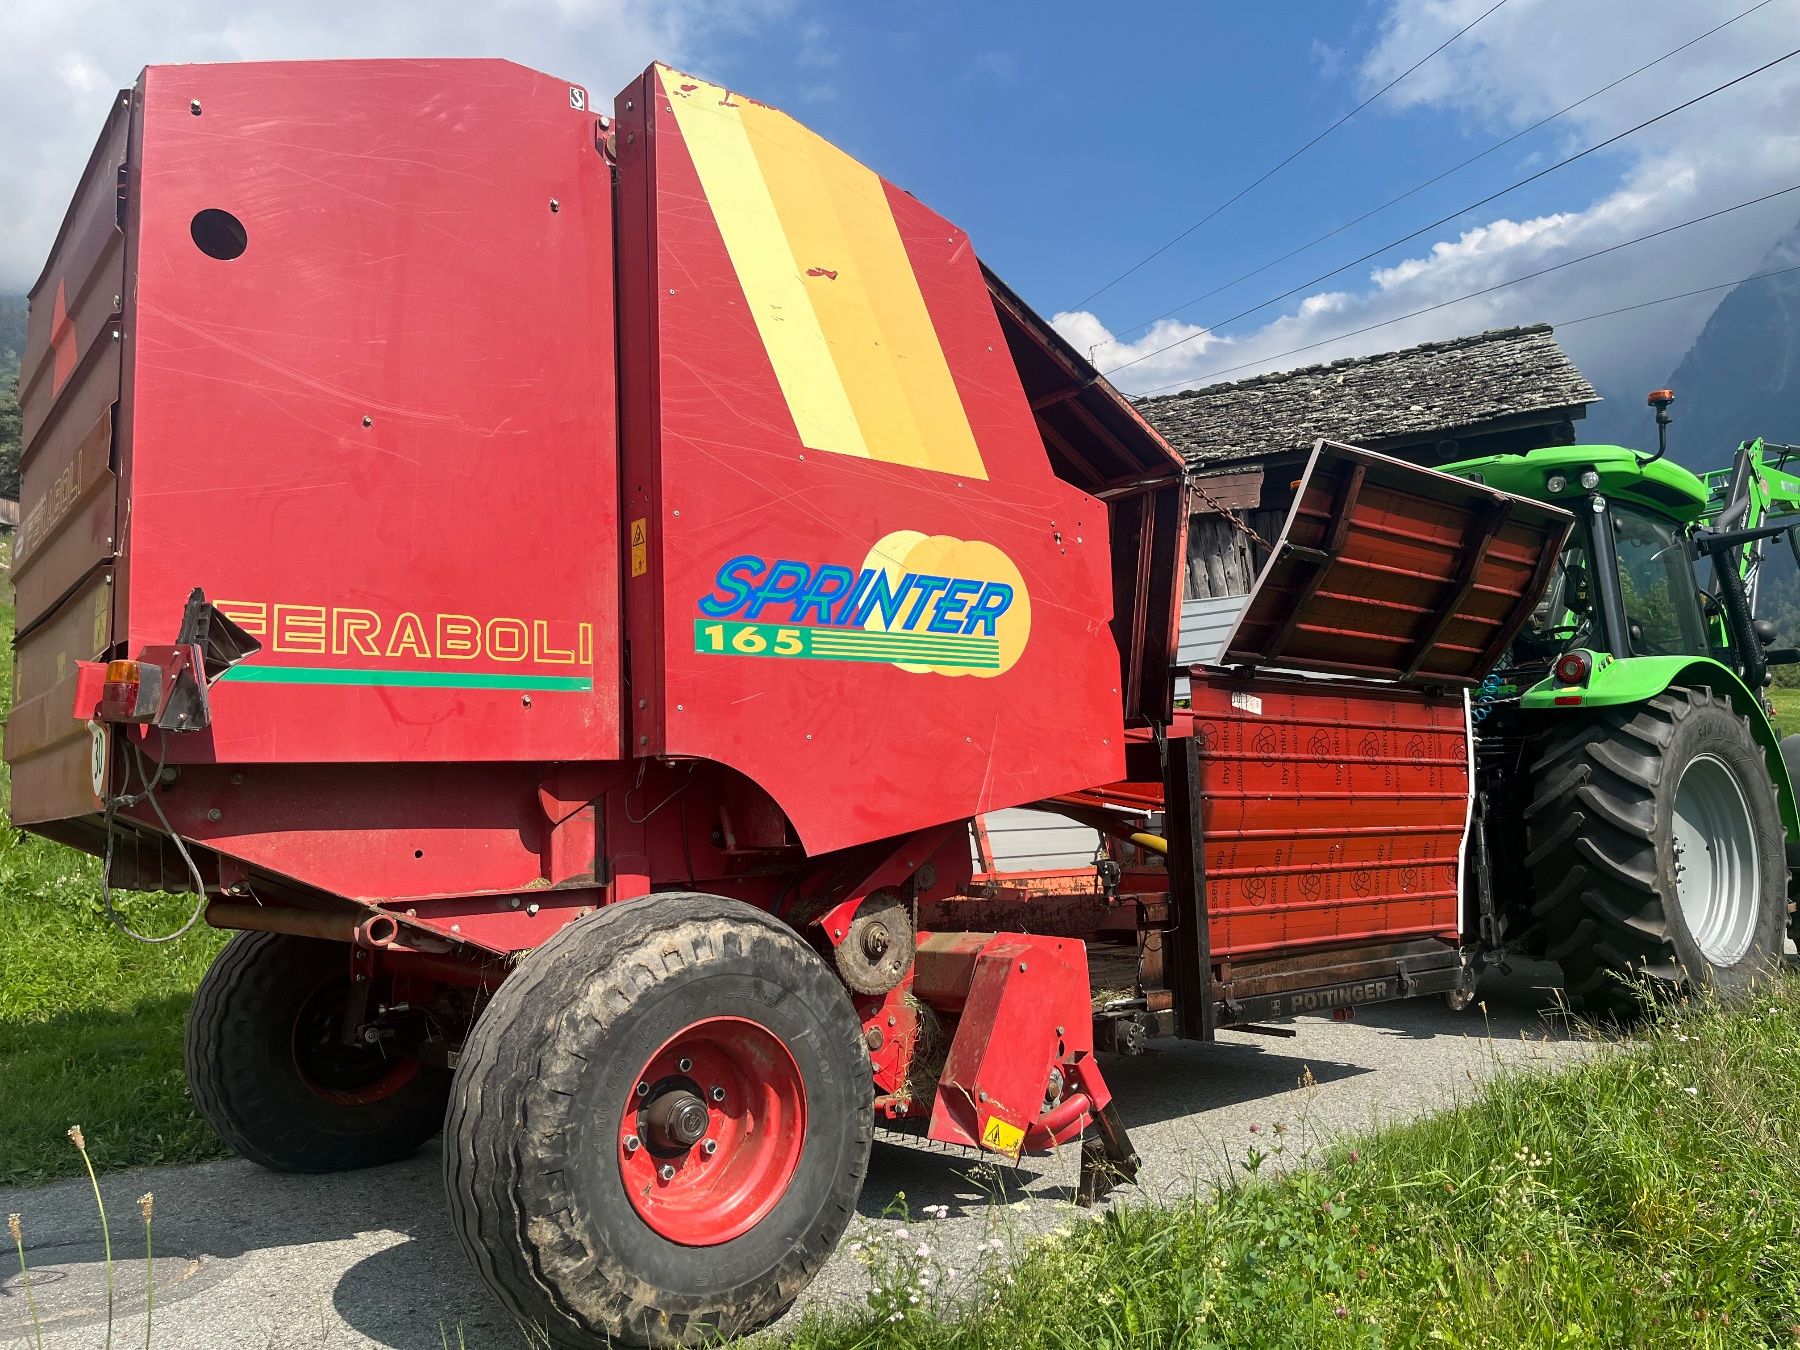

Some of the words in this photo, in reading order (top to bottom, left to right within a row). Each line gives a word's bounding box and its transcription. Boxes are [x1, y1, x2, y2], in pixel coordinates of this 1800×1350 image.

[697, 554, 1014, 637] SPRINTER
[213, 600, 593, 665] FERABOLI
[704, 624, 804, 656] 165
[94, 731, 103, 780] 30
[1290, 981, 1388, 1012] PÖTTINGER
